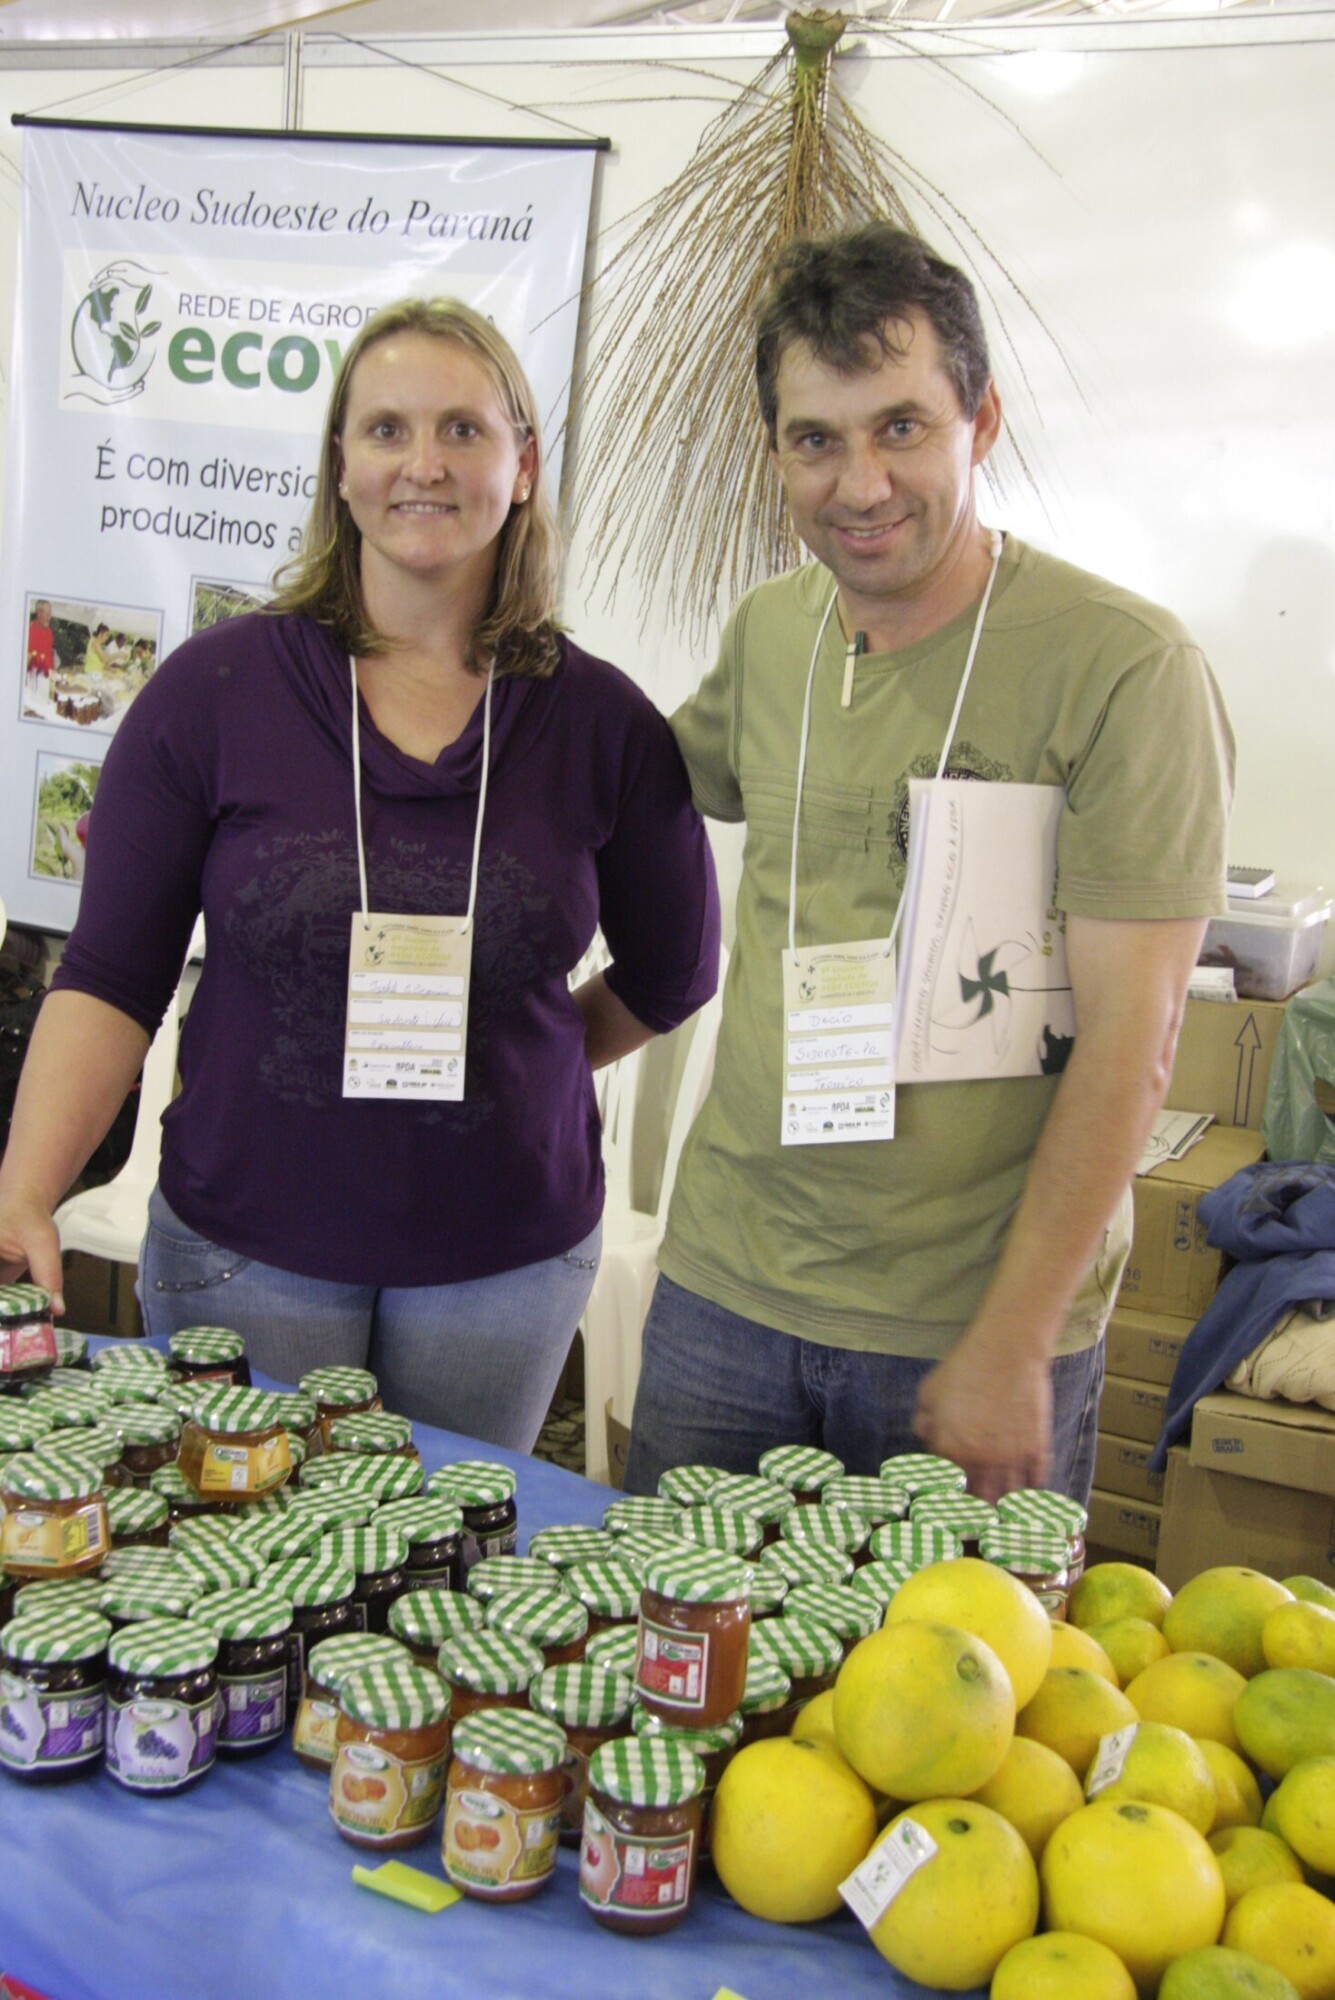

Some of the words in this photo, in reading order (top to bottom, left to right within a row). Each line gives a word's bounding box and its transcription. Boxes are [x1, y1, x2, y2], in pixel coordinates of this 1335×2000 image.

[71, 181, 180, 223] Nucleo
[191, 188, 338, 232] Sudoeste
[347, 196, 390, 234] do
[400, 200, 534, 242] Paraná
[178, 293, 241, 320] REDE
[248, 299, 282, 323] DE
[289, 302, 379, 329] AGROE
[168, 326, 345, 394] ecov
[95, 438, 116, 480] É
[126, 453, 190, 487] com
[101, 505, 278, 549] produzimos
